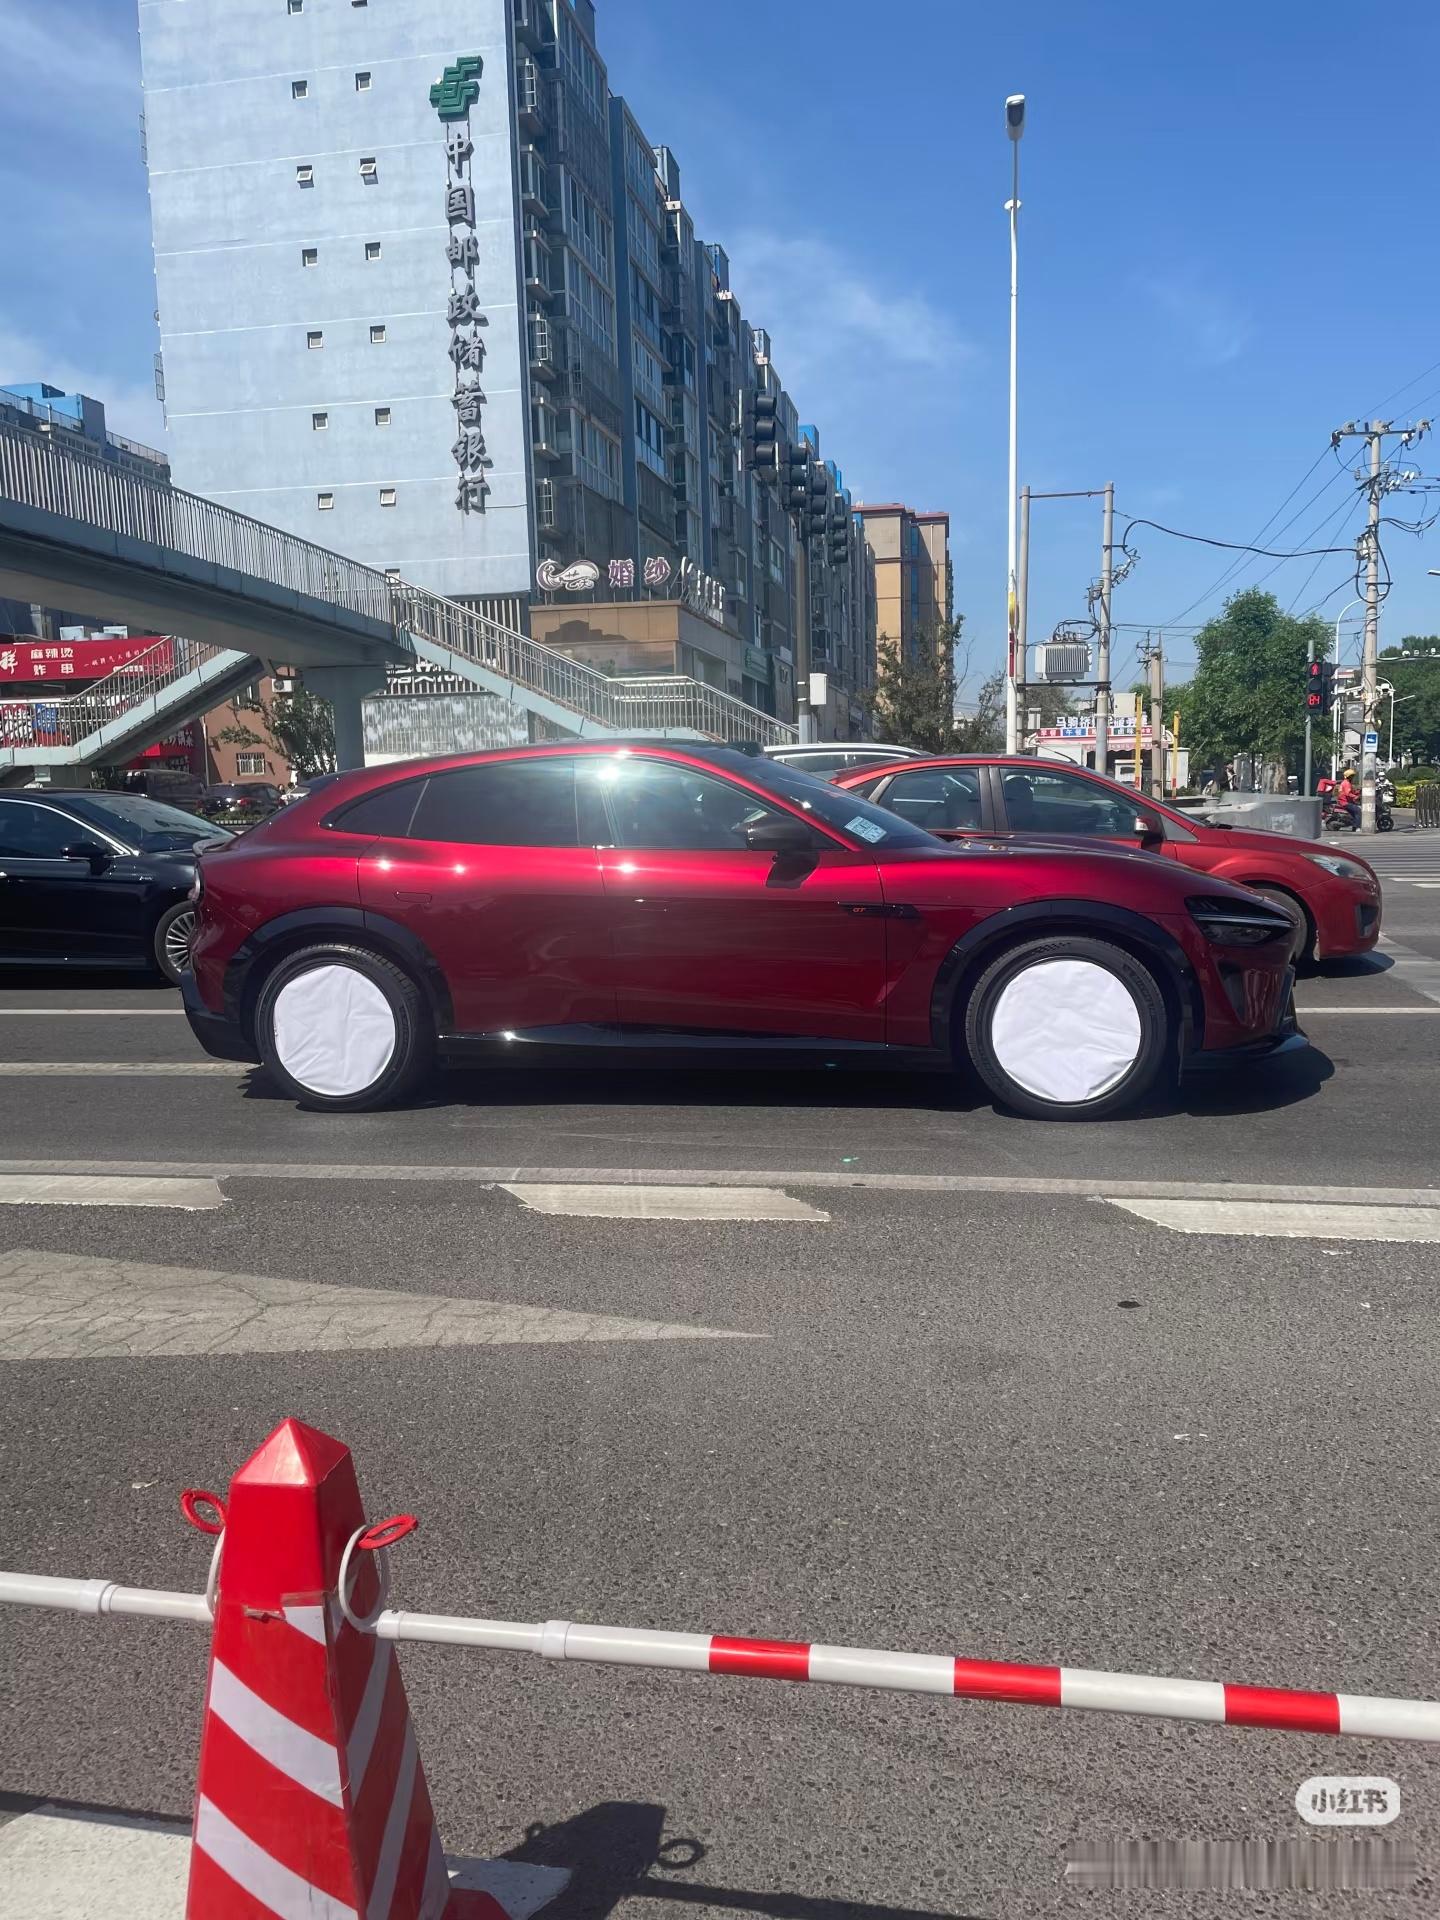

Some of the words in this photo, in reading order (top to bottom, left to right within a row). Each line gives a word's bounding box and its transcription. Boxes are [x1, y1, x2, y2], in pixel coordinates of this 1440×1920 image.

[445, 133, 493, 514] 中国邮政储蓄银行
[608, 557, 671, 588] 婚纱
[30, 647, 74, 660] 麻辣烫
[33, 663, 75, 676] 炸串
